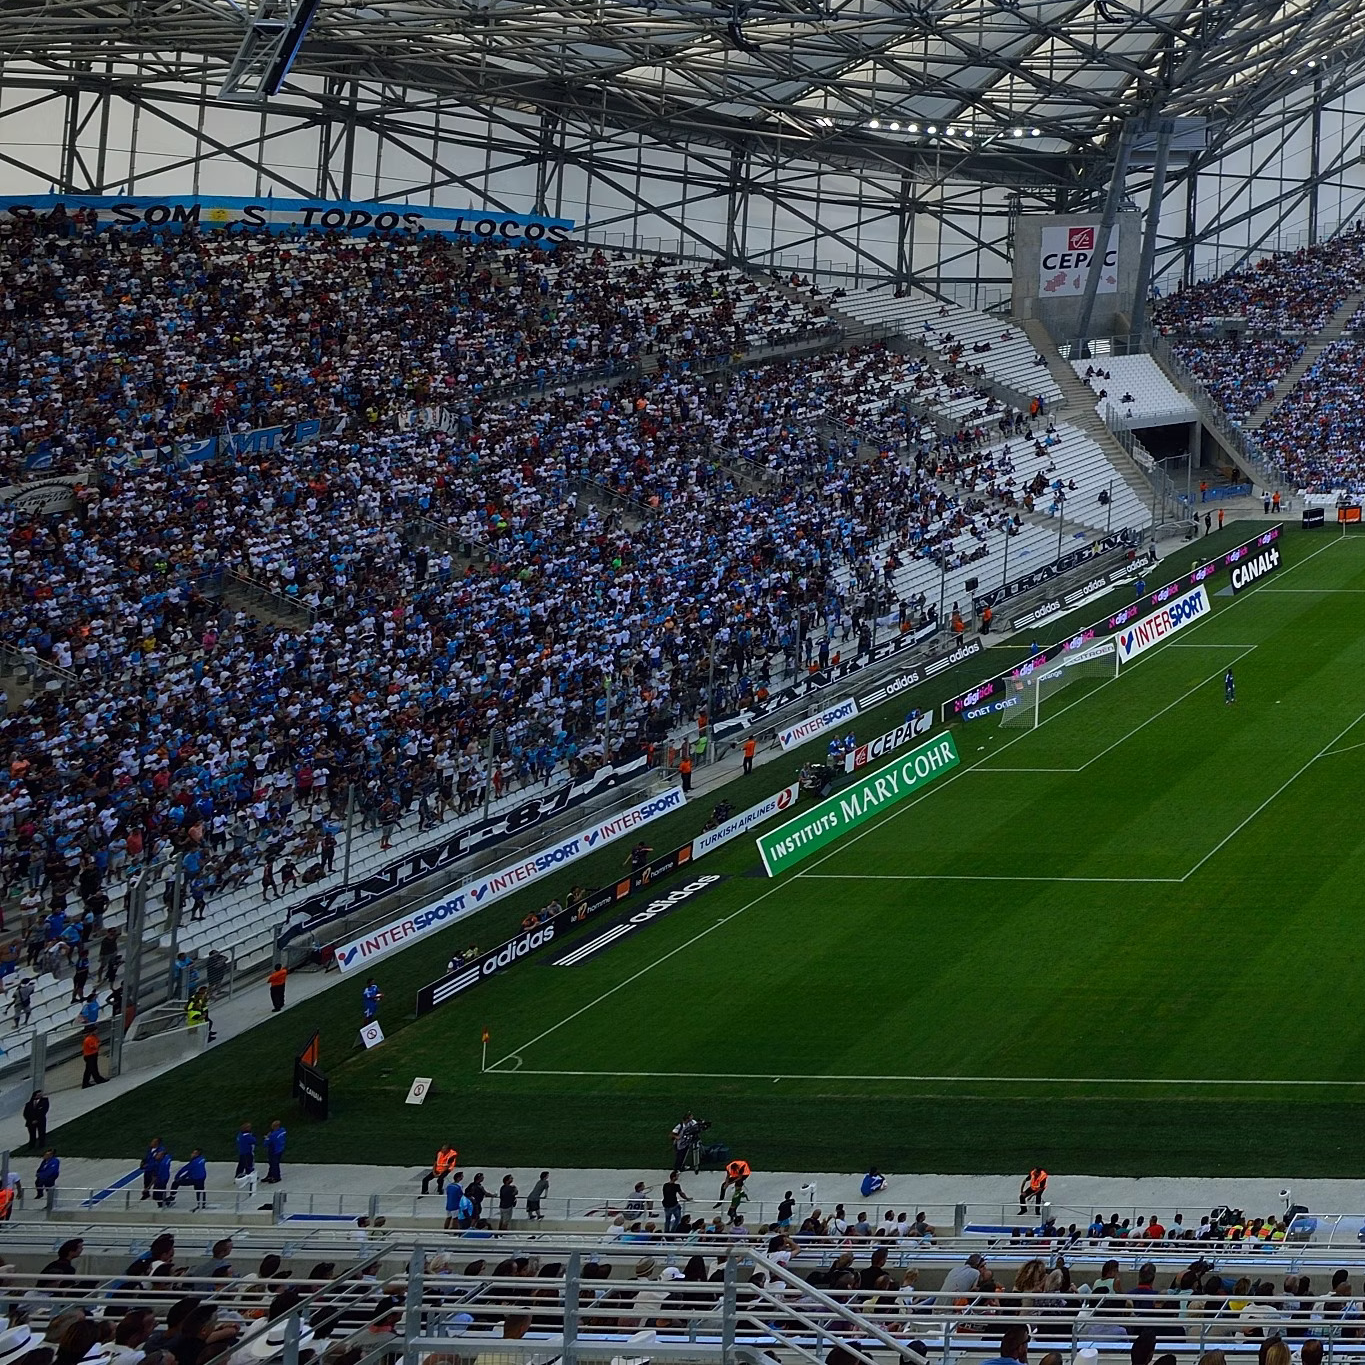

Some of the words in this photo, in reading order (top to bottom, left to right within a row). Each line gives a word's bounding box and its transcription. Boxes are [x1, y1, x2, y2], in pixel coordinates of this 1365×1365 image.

[300, 207, 425, 235] TODOS
[455, 216, 571, 244] LOCOS
[1262, 530, 1279, 544] digitick
[1231, 546, 1248, 561] digitick
[1126, 558, 1149, 573] adidas
[1196, 564, 1215, 579] digitick
[1232, 548, 1279, 589] CANAL+
[1083, 577, 1106, 594] adidas
[1158, 584, 1179, 601] digitick
[1034, 599, 1061, 620] adidas
[1115, 606, 1138, 623] digitick
[1135, 591, 1205, 648] INTERSPORT
[1070, 630, 1095, 649] digitick
[949, 641, 980, 664] adidas
[886, 671, 919, 695] adidas
[964, 683, 994, 707] digitick
[967, 705, 991, 719] ONET
[995, 697, 1018, 712] ONET
[793, 704, 854, 740] INTERSPORT
[871, 716, 925, 758] CEPAC
[770, 812, 838, 861] INSTITUTS
[840, 769, 900, 824] MARY
[902, 741, 955, 785] COHR
[700, 822, 738, 850] TURKISH
[738, 801, 776, 828] AIRLINES
[359, 895, 465, 957] INTERSPORT
[489, 839, 580, 894] INTERSPORT
[600, 791, 681, 840] INTERSPORT
[651, 861, 674, 877] homme
[587, 895, 611, 914] homme
[630, 874, 721, 923] adidas
[483, 924, 555, 975] adidas
